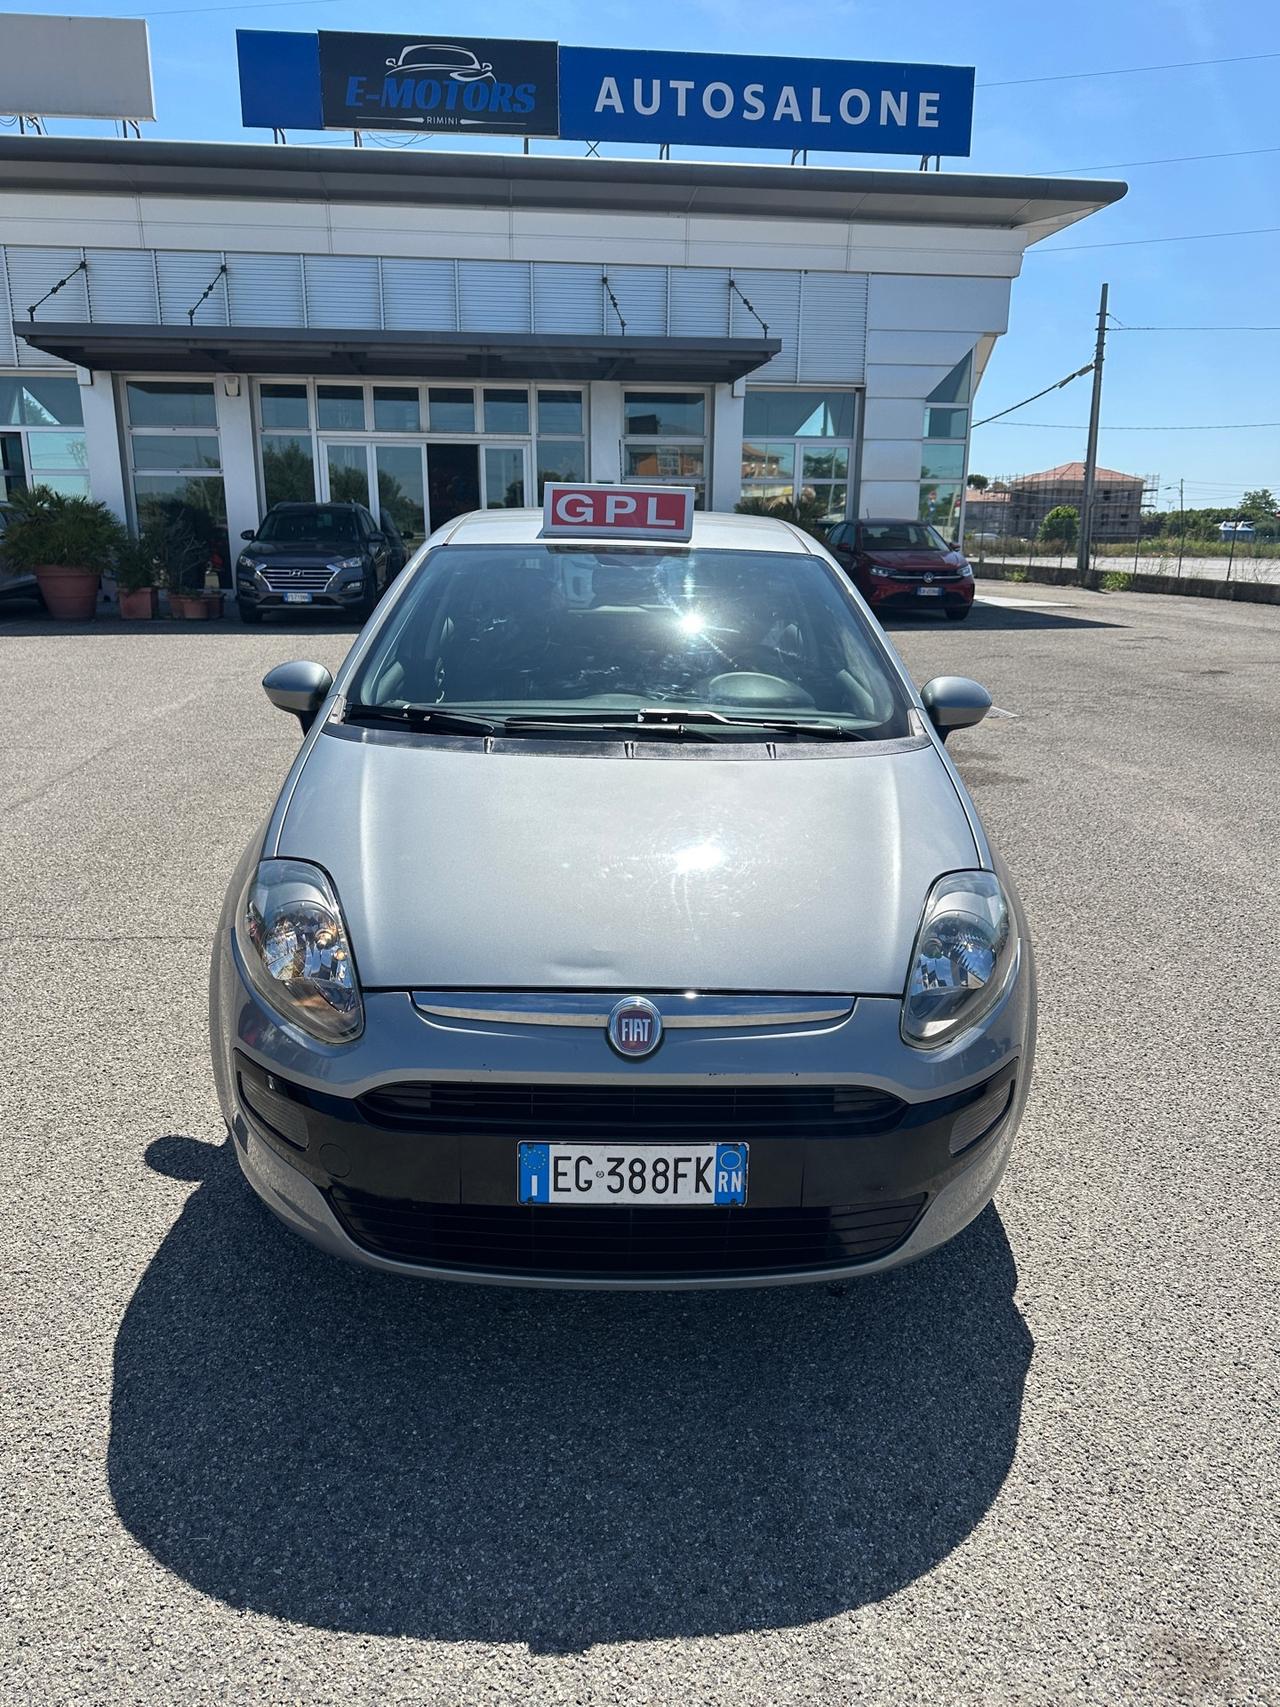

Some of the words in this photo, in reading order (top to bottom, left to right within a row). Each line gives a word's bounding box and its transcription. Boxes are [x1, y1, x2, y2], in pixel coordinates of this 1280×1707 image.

[345, 76, 536, 113] E-MOTORS
[594, 76, 941, 128] AUTOSALONE
[426, 116, 459, 126] RIMINI
[556, 493, 676, 527] GPL
[621, 1018, 651, 1042] FIAT
[718, 1171, 742, 1193] RN
